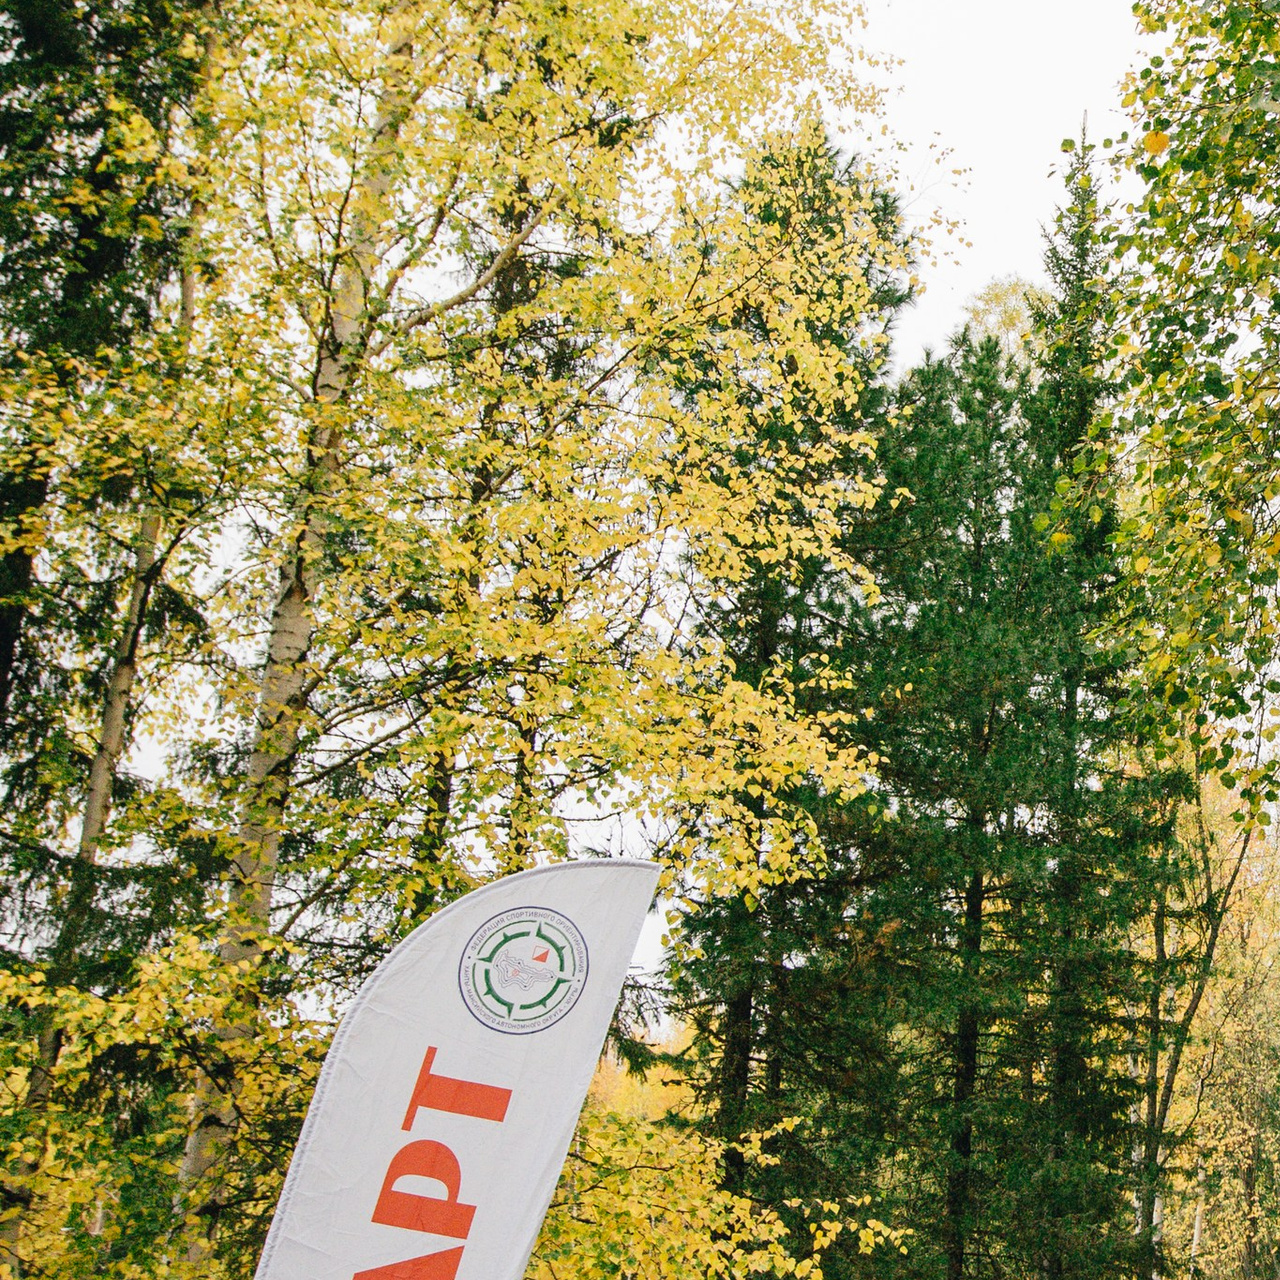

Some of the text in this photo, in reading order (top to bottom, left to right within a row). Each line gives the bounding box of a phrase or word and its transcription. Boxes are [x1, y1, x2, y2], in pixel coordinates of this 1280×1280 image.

[471, 911, 585, 973] ФЕДЕРАЦИЯ СПОРТИВНОГО ОРИЕНТИРОВАНИЯ
[496, 1020, 541, 1030] АВТОНОМНОГО
